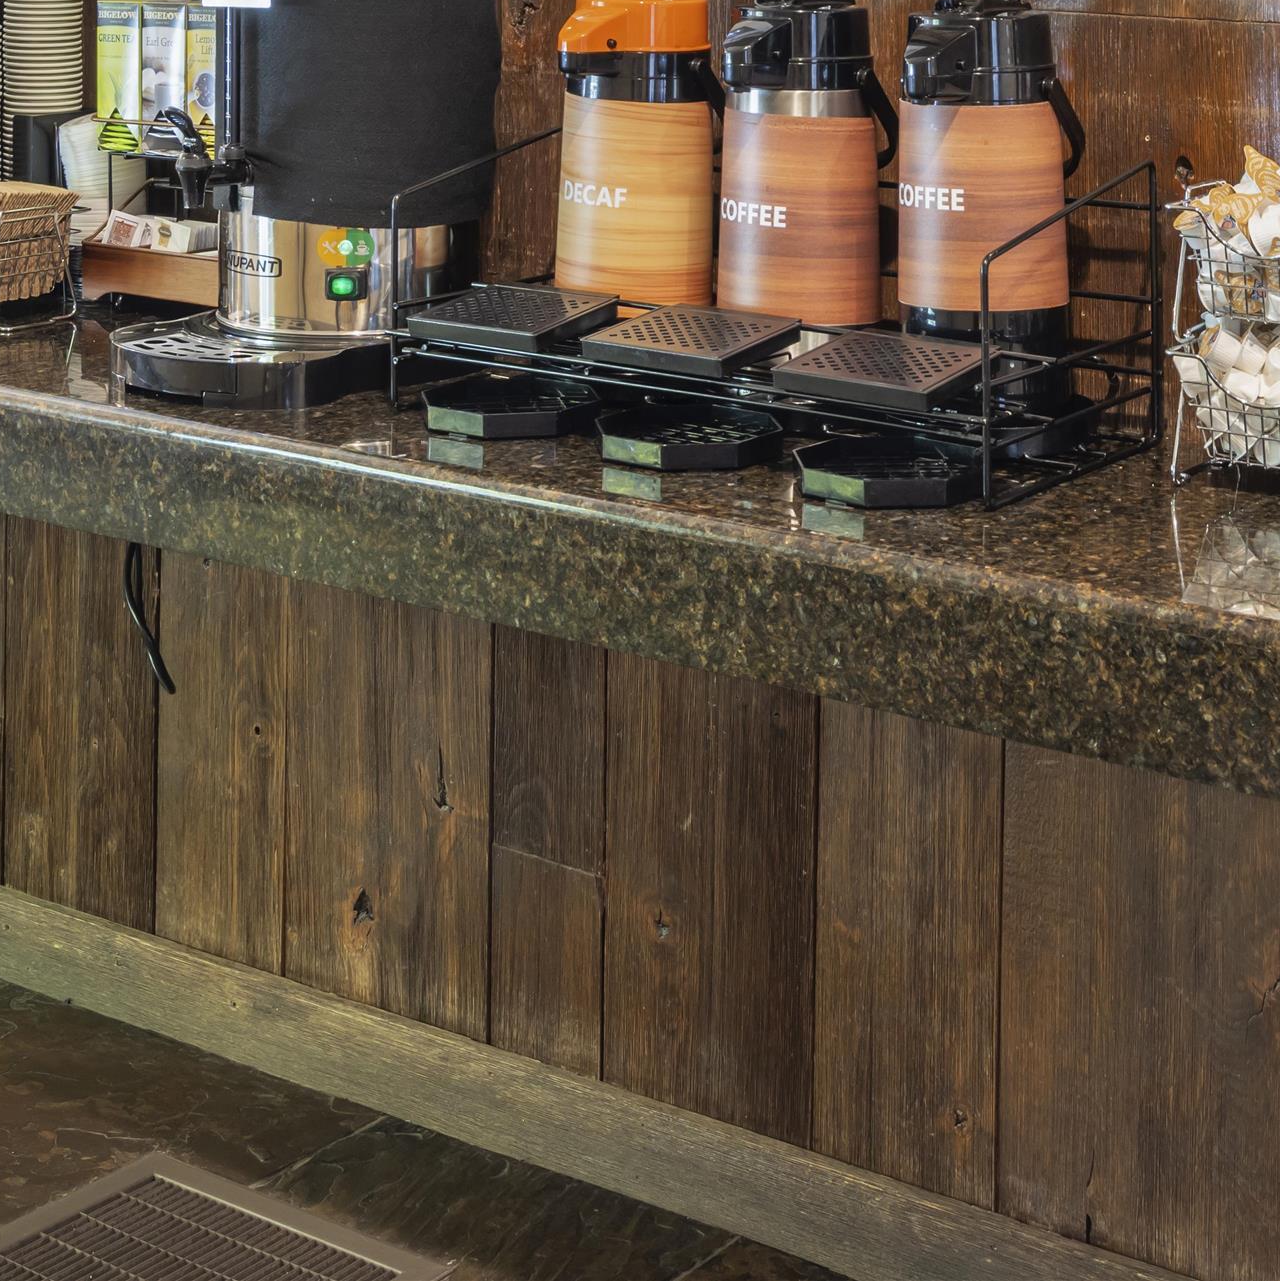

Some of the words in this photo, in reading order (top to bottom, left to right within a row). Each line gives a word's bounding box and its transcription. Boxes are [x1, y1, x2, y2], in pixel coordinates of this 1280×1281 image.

[98, 10, 137, 19] BIGELOW
[98, 33, 120, 43] GREEN
[195, 33, 215, 44] Lemo
[564, 180, 627, 208] DECAF
[899, 182, 965, 212] COFFEE
[721, 197, 786, 228] COFFEE
[227, 255, 278, 273] NUPANT
